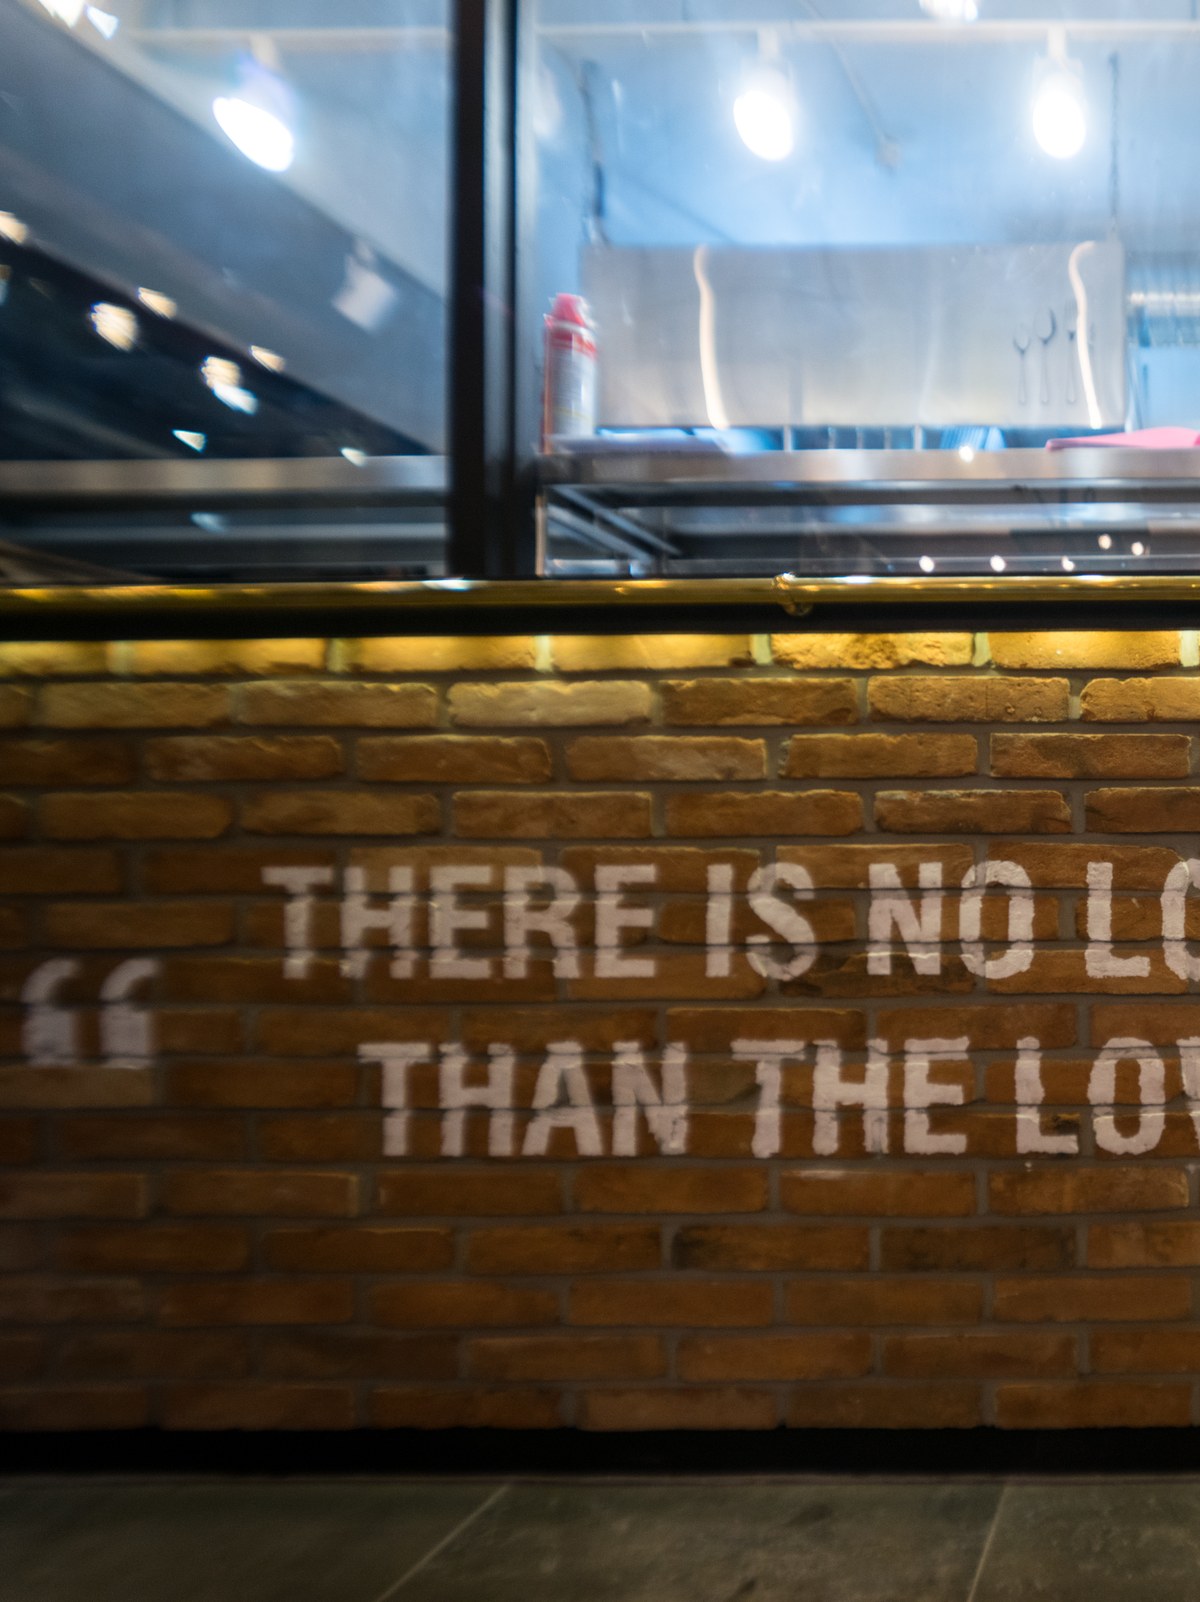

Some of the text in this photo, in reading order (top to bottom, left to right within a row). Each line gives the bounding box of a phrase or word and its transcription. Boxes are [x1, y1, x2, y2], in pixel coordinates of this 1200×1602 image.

[262, 864, 656, 979] THERE
[706, 862, 817, 982] IS
[868, 860, 1035, 980] NO
[358, 1041, 688, 1157] THAN
[731, 1036, 970, 1158] THE
